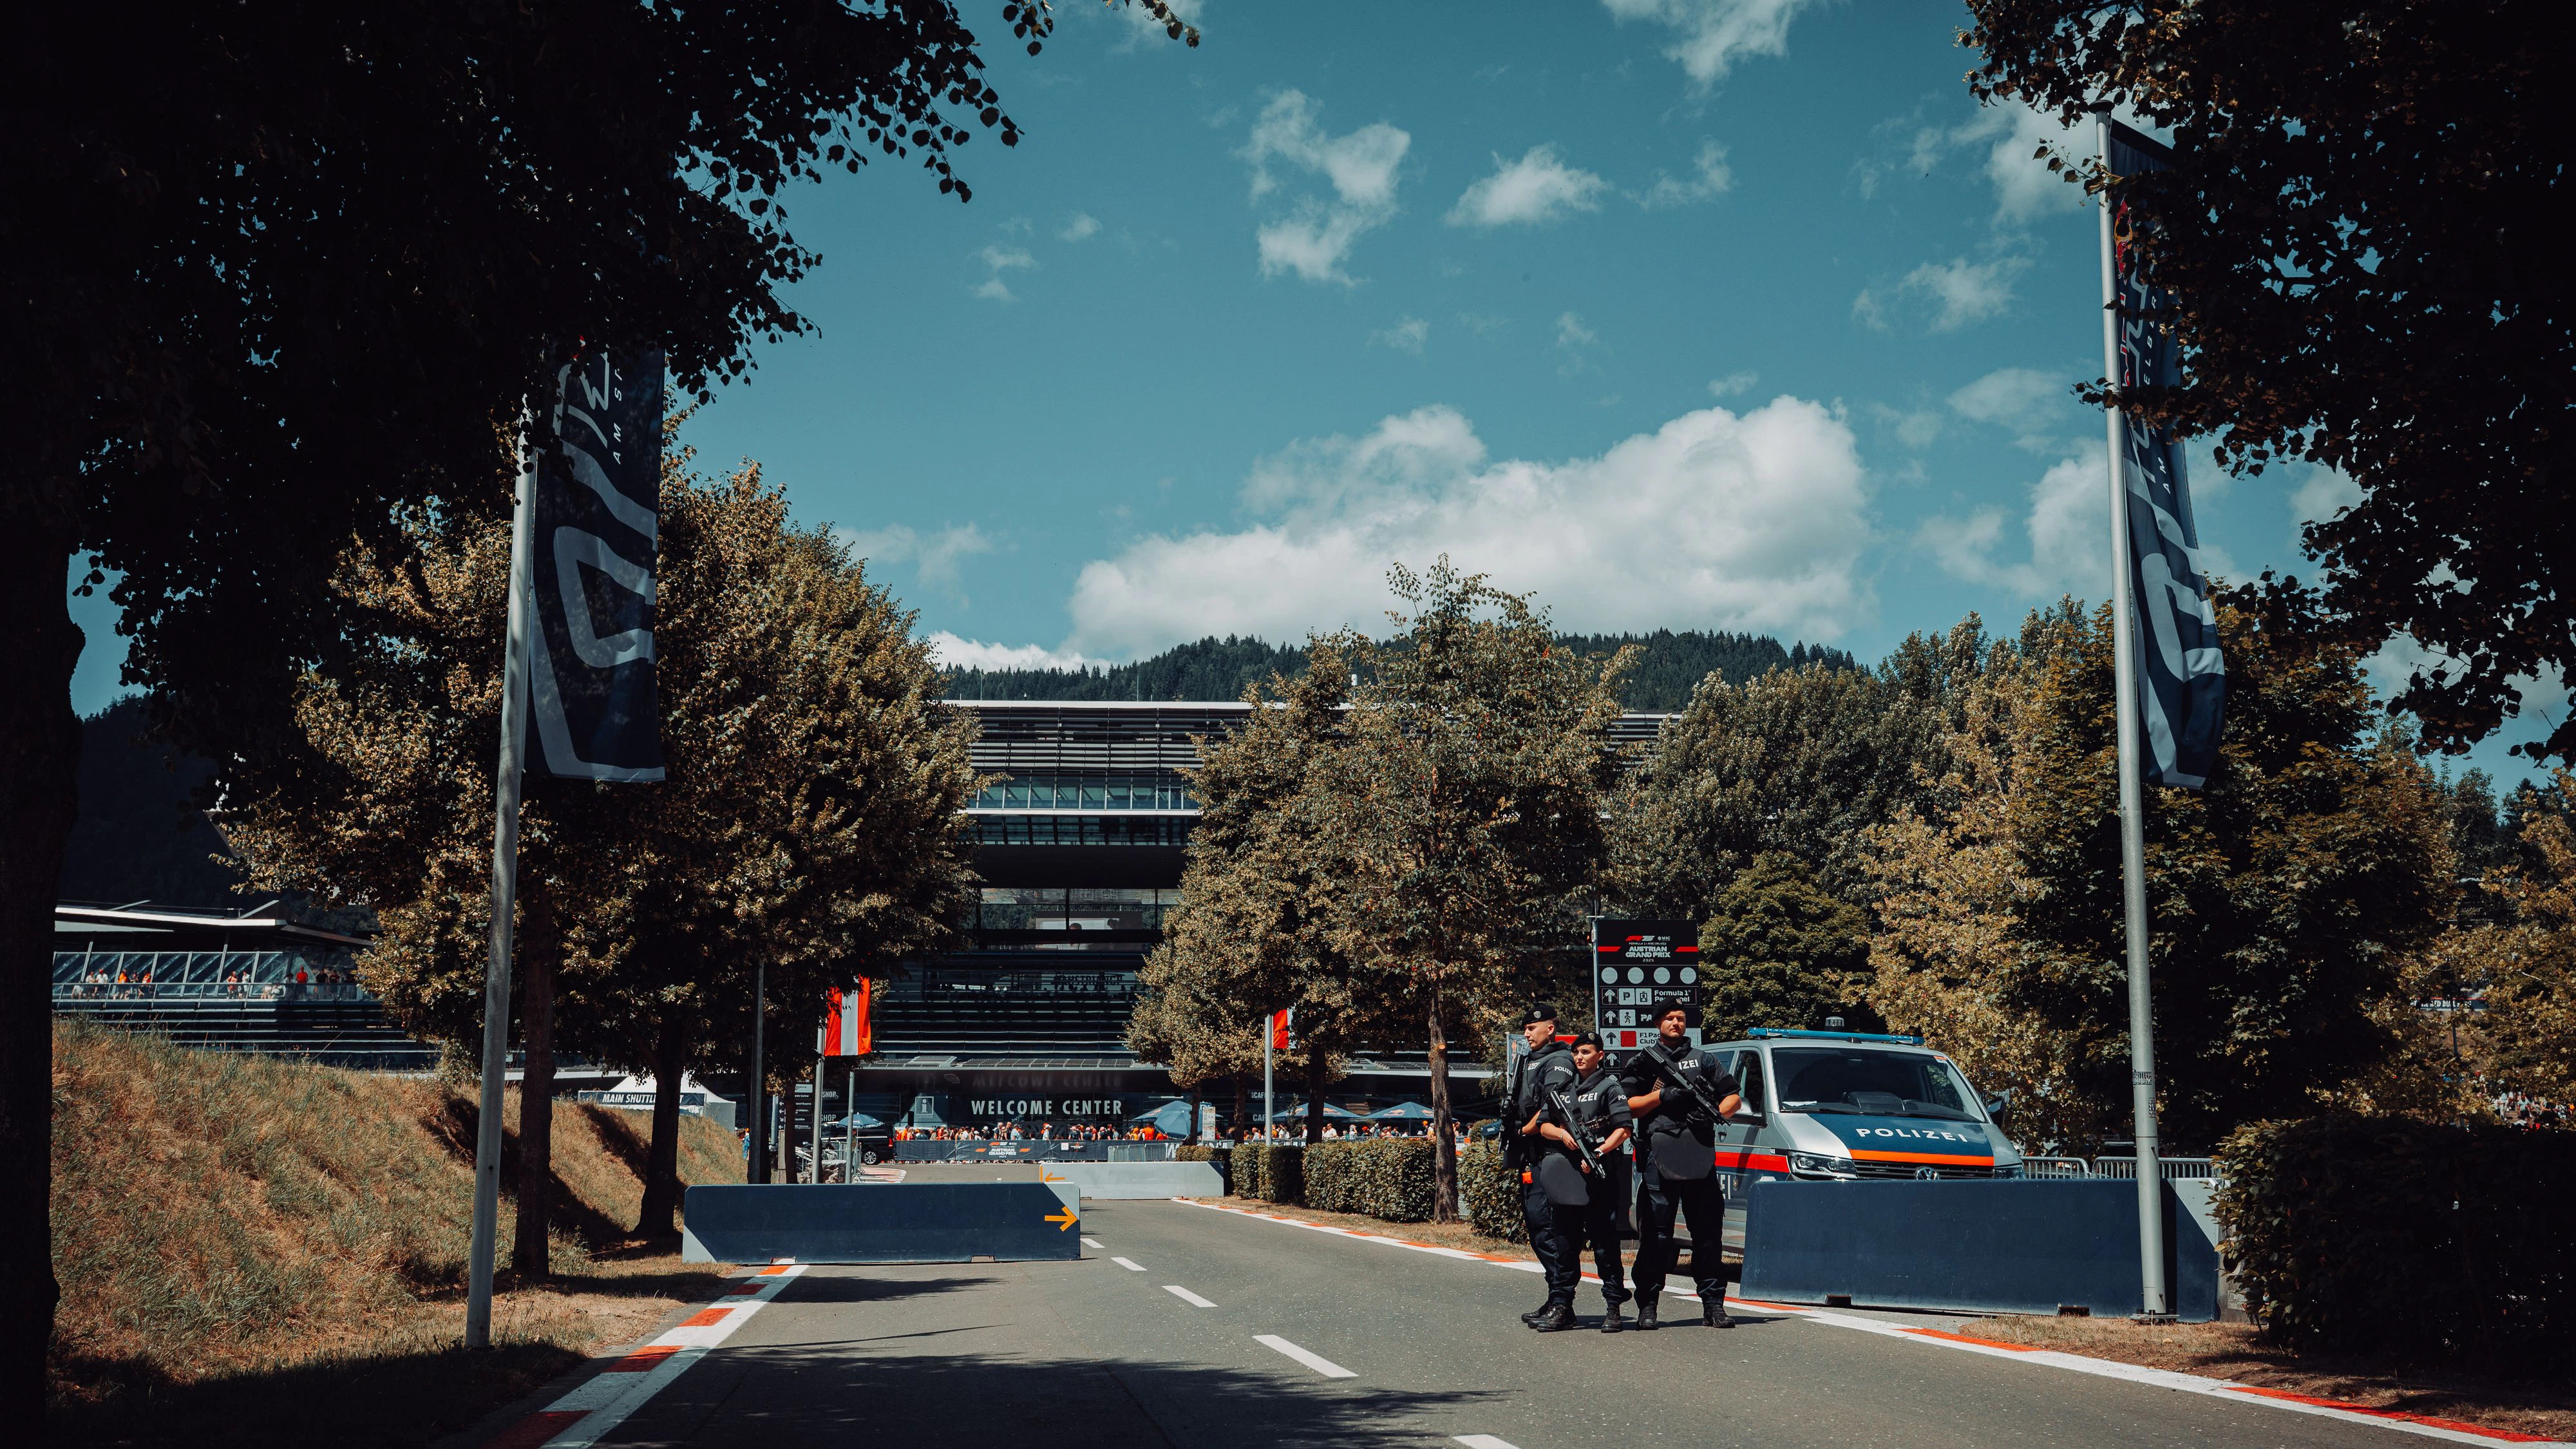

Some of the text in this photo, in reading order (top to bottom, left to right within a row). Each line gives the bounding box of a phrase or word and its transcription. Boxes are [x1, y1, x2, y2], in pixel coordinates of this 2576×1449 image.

[1678, 1059, 1699, 1070] IZEI
[1554, 1066, 1573, 1077] POLIZEI
[602, 1094, 656, 1103] MAIN SHUTTL
[1560, 1092, 1598, 1104] POIZEI
[971, 1100, 1122, 1115] WELCOME CENTER
[1855, 1128, 1968, 1142] POLIZEI
